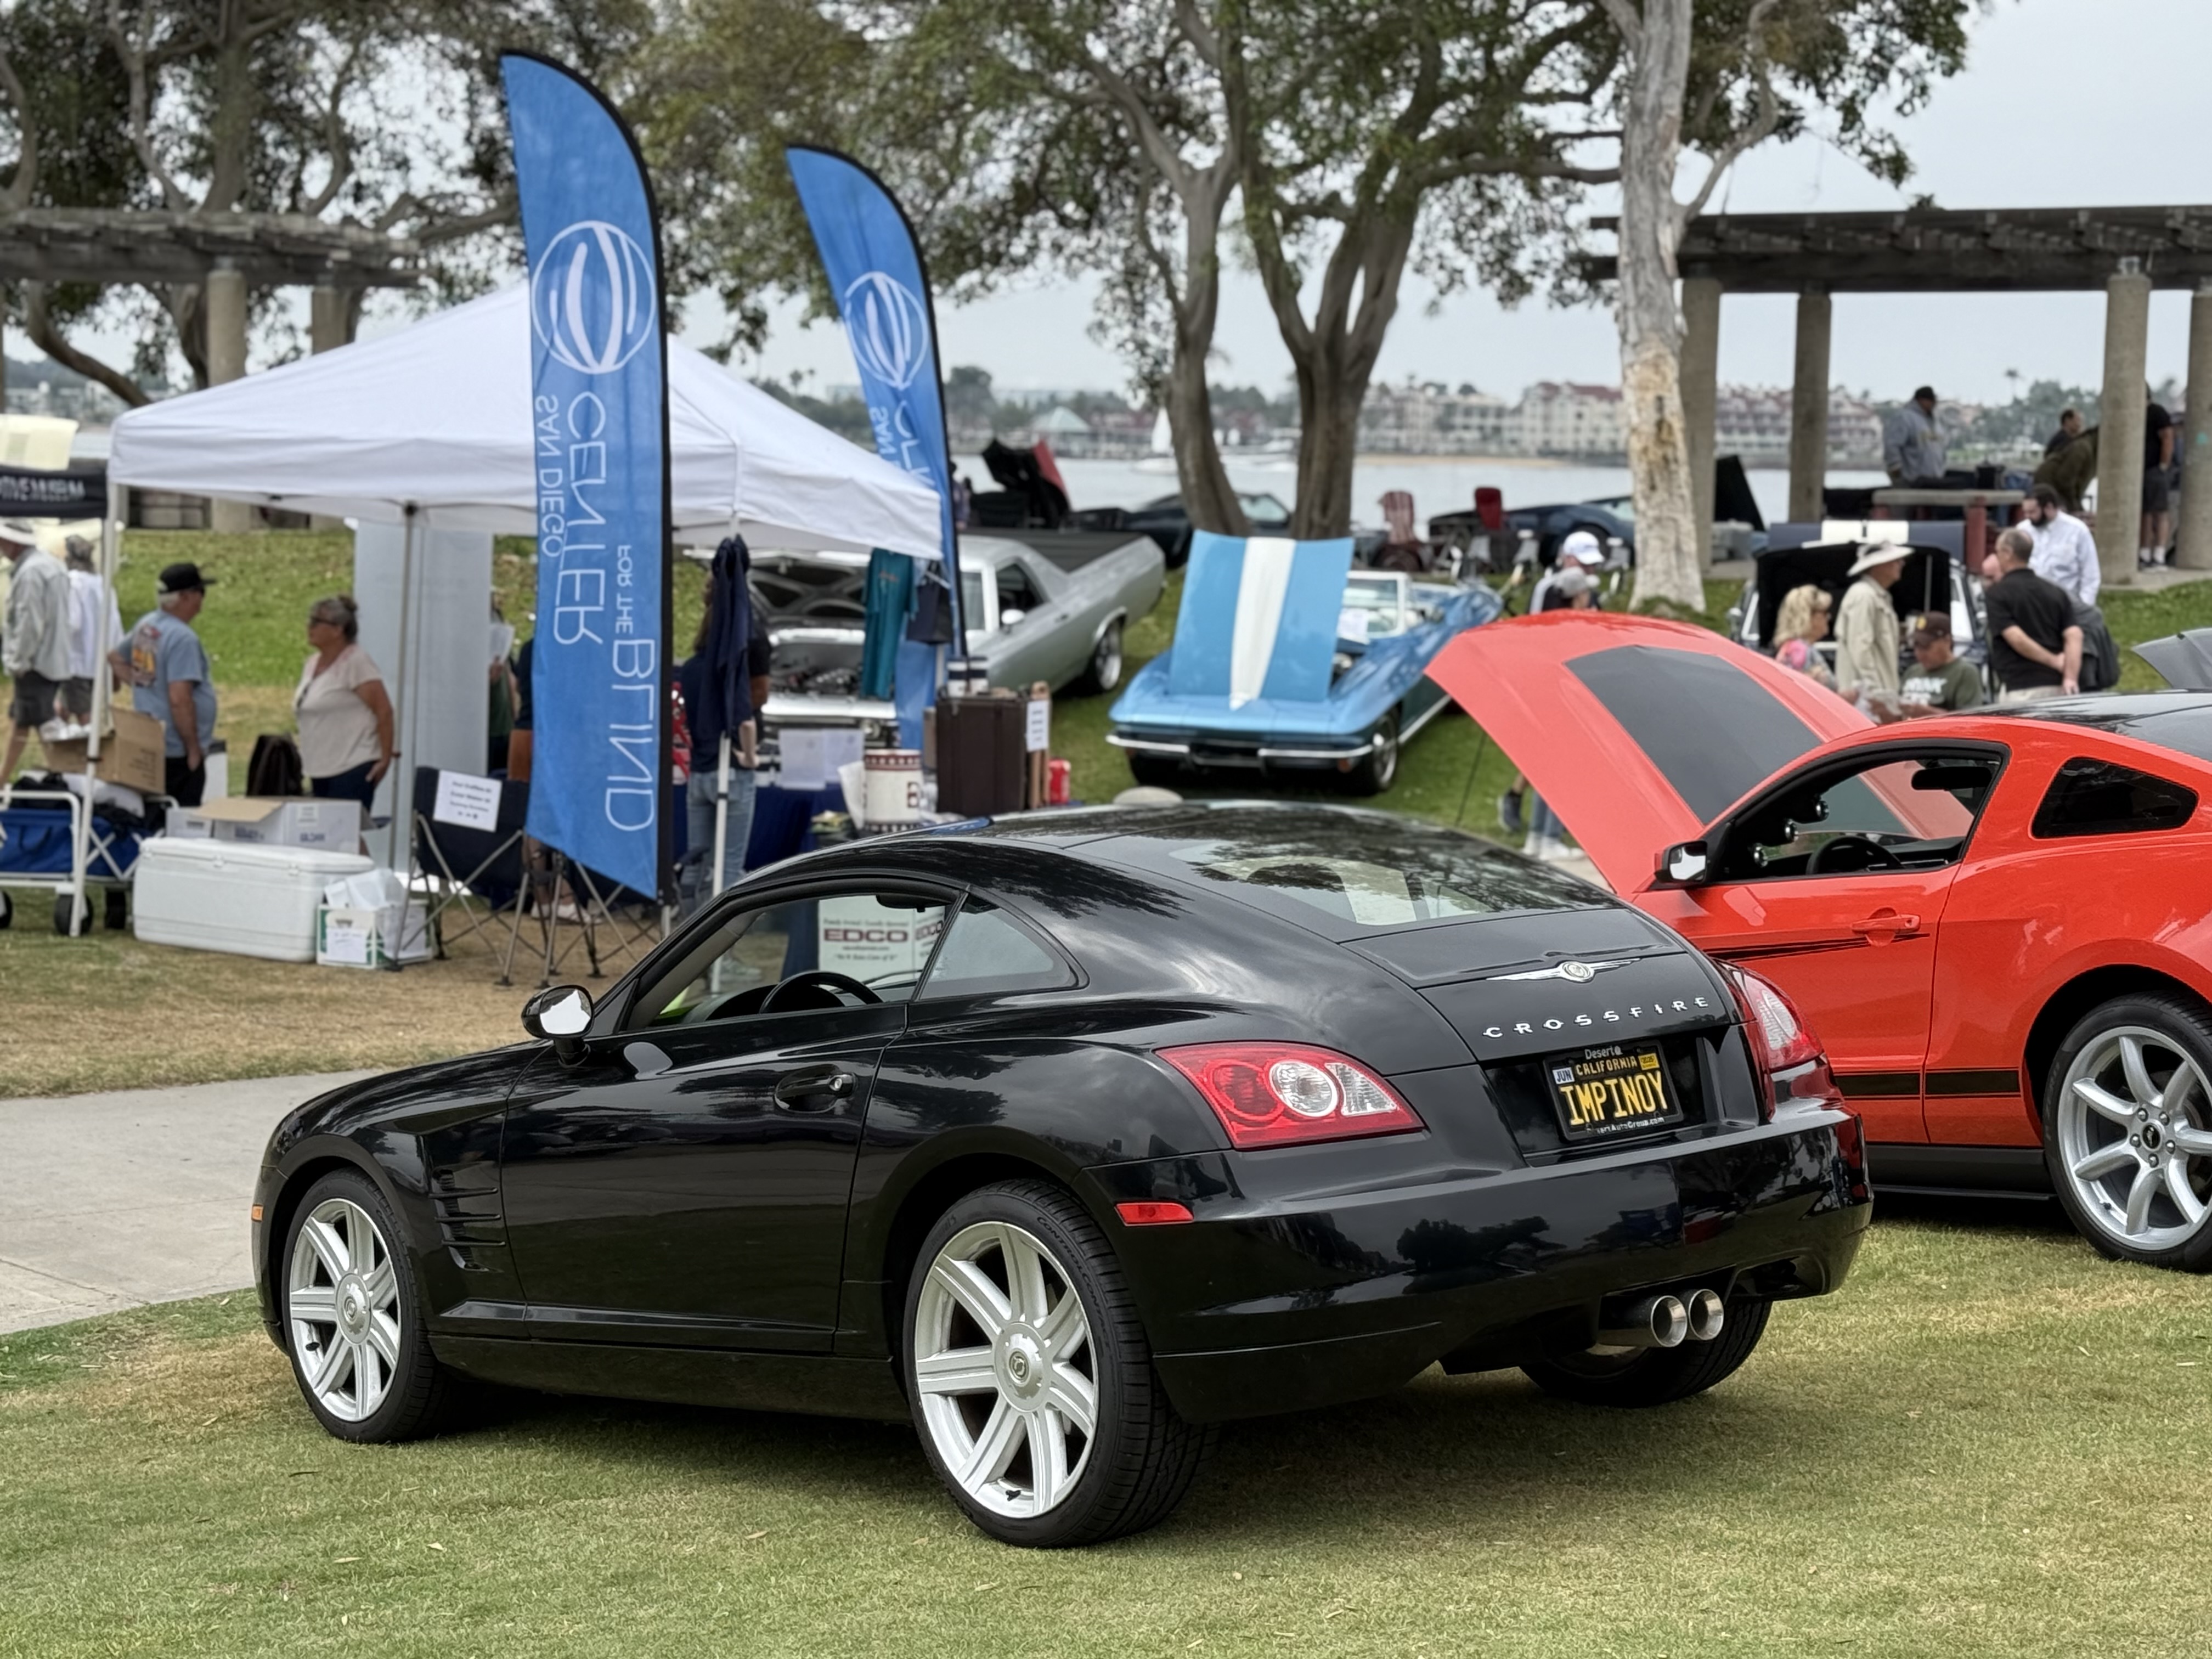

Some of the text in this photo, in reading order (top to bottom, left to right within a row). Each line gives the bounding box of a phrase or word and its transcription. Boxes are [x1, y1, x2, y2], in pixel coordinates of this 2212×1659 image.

[824, 928, 909, 943] EDCO
[1483, 997, 1709, 1039] CROSSFIRE
[1556, 1070, 1573, 1082] JUN
[1576, 1056, 1638, 1076] CALIFORNIA
[1560, 1070, 1668, 1126] IMPINOY
